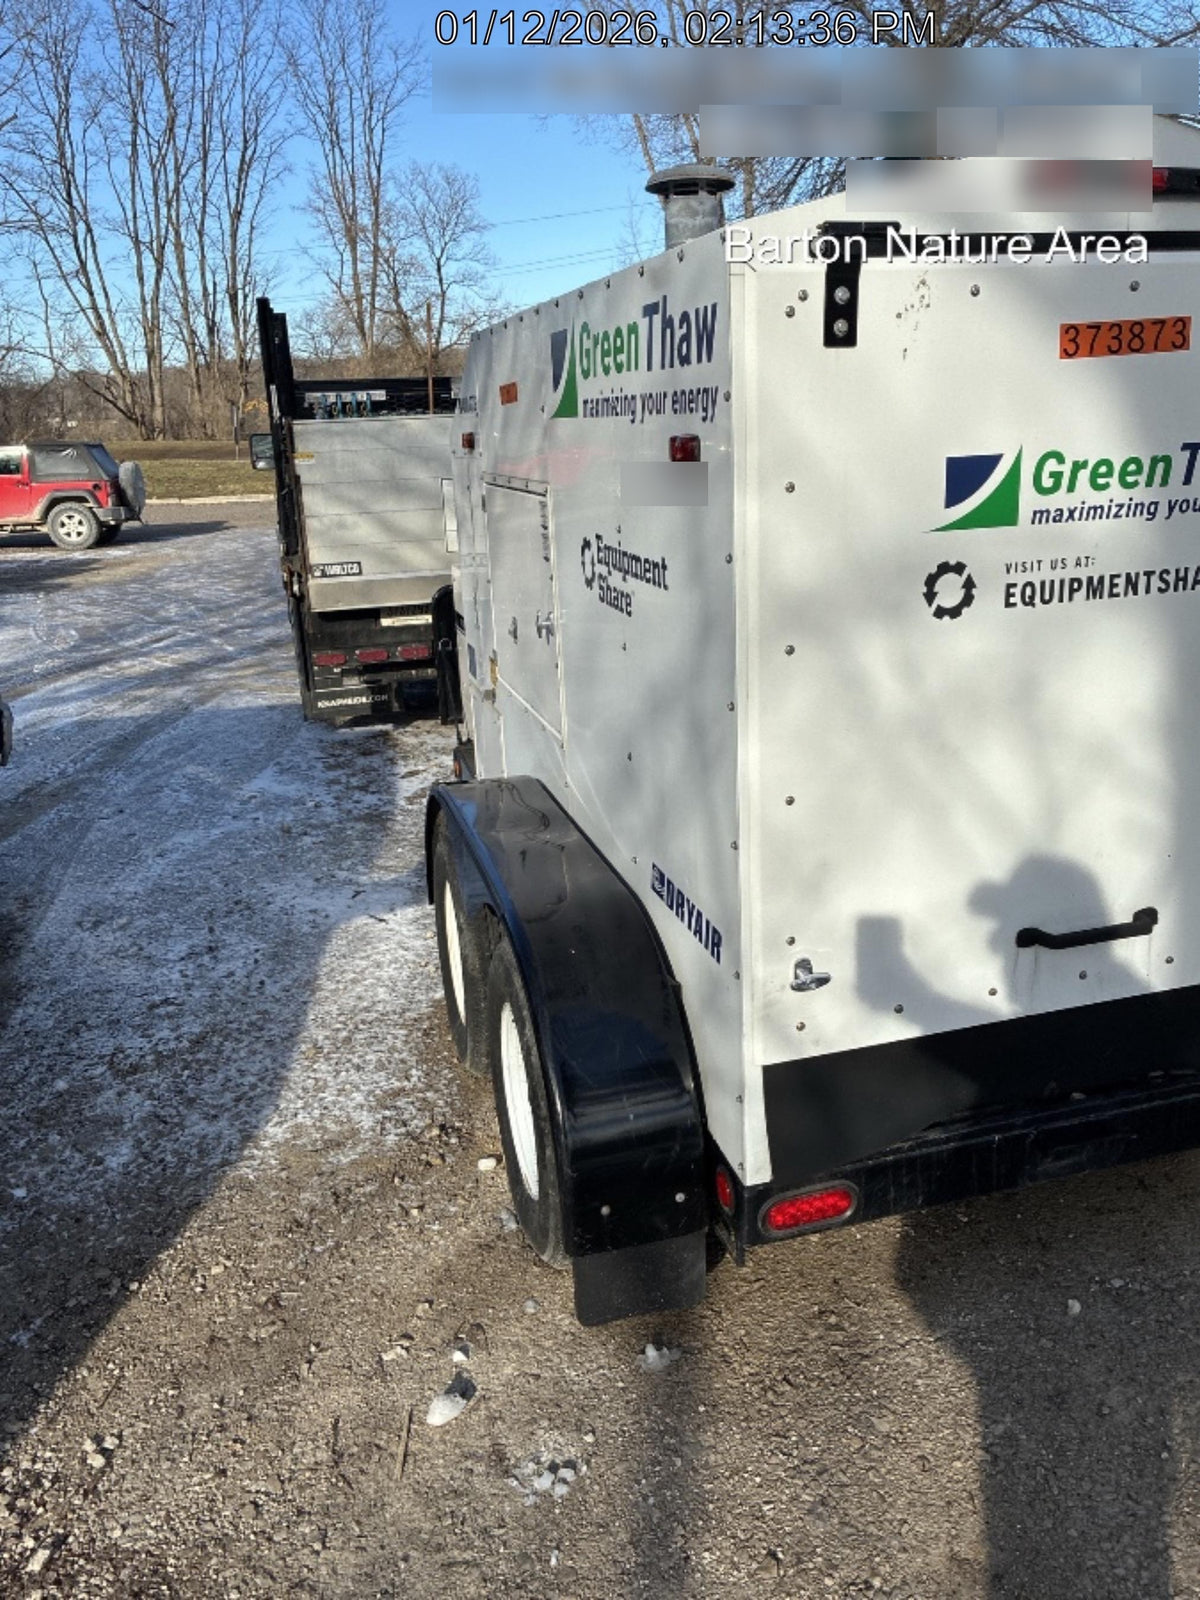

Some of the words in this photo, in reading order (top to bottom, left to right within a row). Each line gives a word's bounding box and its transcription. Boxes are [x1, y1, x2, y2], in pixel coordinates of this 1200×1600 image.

[1062, 317, 1188, 357] 373873
[640, 391, 667, 424] your
[671, 385, 718, 423] energy
[1030, 498, 1159, 525] maximizing
[595, 532, 669, 591] Equipment
[1005, 557, 1043, 574] VISIT
[1050, 556, 1068, 570] US
[1075, 555, 1096, 569] AT:
[598, 572, 632, 618] Share
[665, 876, 723, 966] DRYAIR
